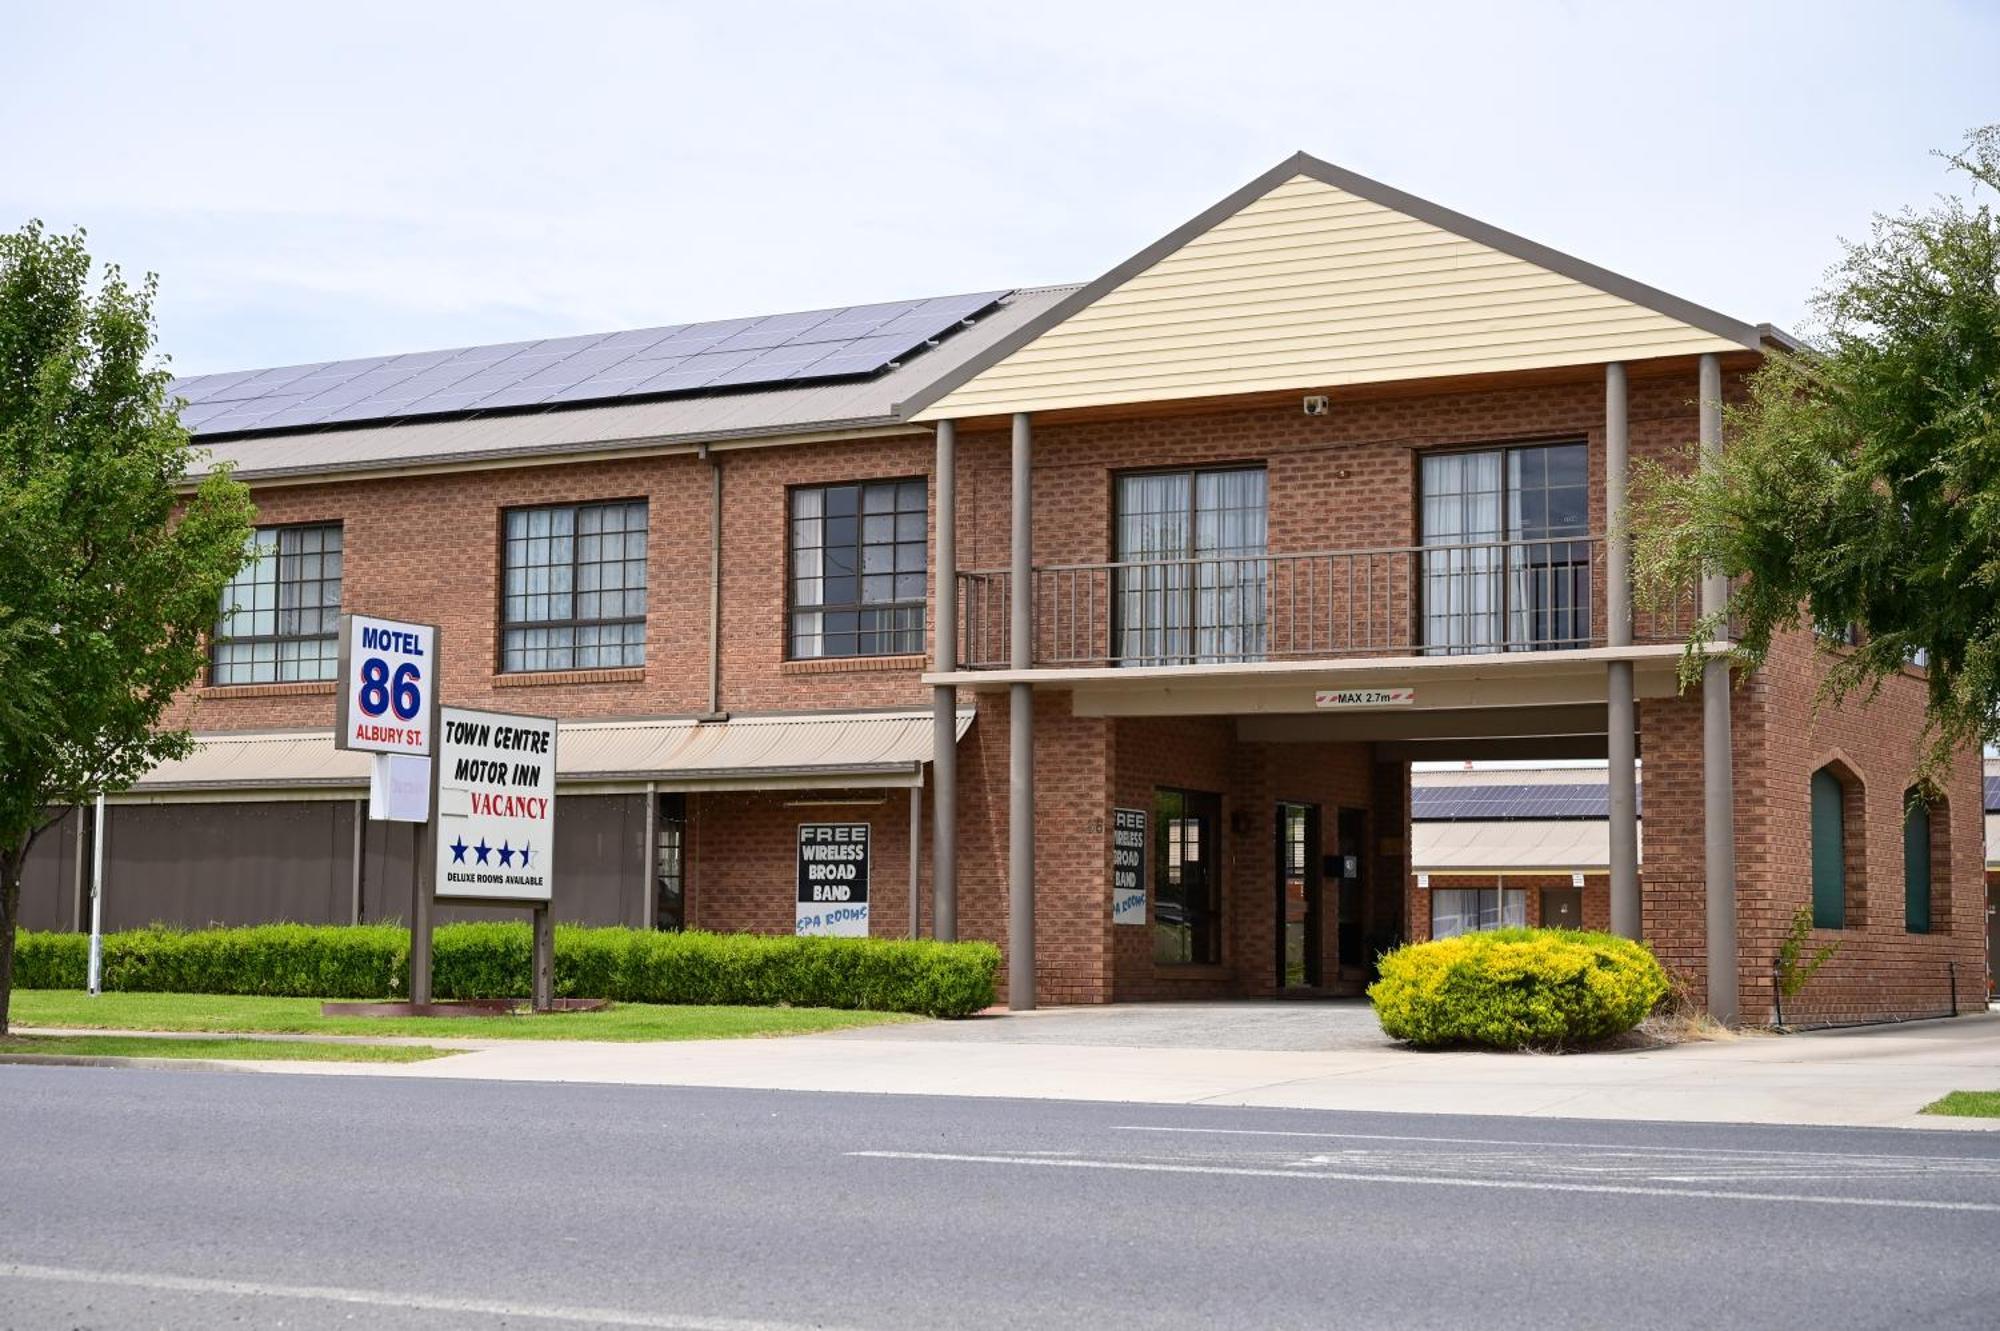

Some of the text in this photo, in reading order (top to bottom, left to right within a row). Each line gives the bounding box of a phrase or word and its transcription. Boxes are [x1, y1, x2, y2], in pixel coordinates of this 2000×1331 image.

[362, 626, 424, 656] MOTEL
[359, 657, 421, 721] 86
[1338, 692, 1391, 704] MAX 2.7m
[356, 724, 423, 746] ALBURY ST.
[446, 720, 550, 754] TOWN CENTRE
[454, 758, 541, 787] MOTOR INN
[471, 792, 549, 819] VACANCY
[1114, 812, 1144, 829] REE
[800, 827, 866, 842] FREE
[1114, 830, 1144, 848] IRELESS
[802, 844, 864, 861] WIRELESS
[447, 872, 543, 886] DELUXE ROOMS AVAILABLE
[808, 863, 856, 880] BROAD
[1115, 870, 1137, 888] BAND
[813, 885, 851, 901] BAND
[797, 905, 867, 932] SPA ROOMS
